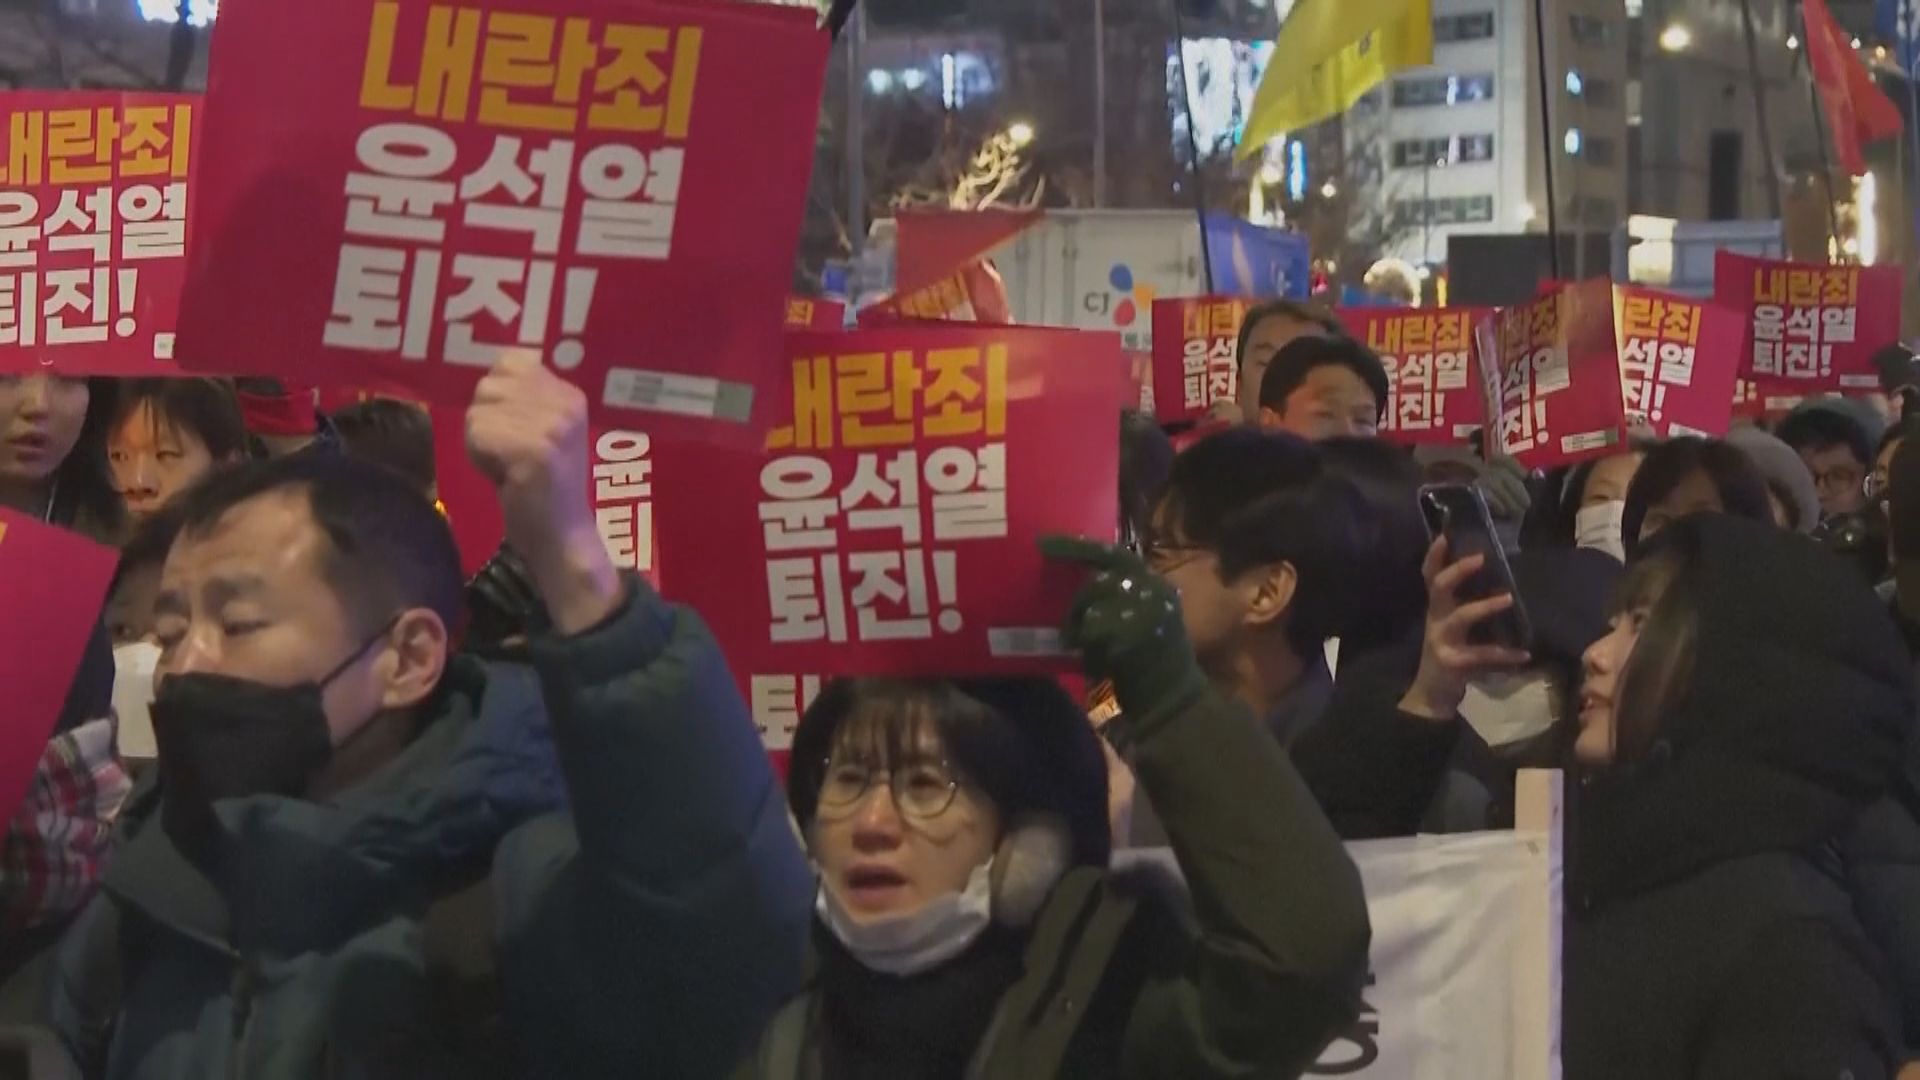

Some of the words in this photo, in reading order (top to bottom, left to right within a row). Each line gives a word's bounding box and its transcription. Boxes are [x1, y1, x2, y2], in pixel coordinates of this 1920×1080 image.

[360, 1, 703, 138] 내란죄
[344, 122, 685, 260] 윤석열
[322, 243, 598, 370] 퇴진!
[1083, 292, 1110, 315] CJ
[1368, 312, 1470, 353] 내란죄
[1754, 268, 1858, 305] 내란죄
[1754, 304, 1857, 343] 윤석열
[765, 343, 1008, 449] 내란죄
[1752, 339, 1832, 379] 퇴진!
[758, 443, 1008, 551] 윤석열
[765, 547, 963, 643] 퇴진!
